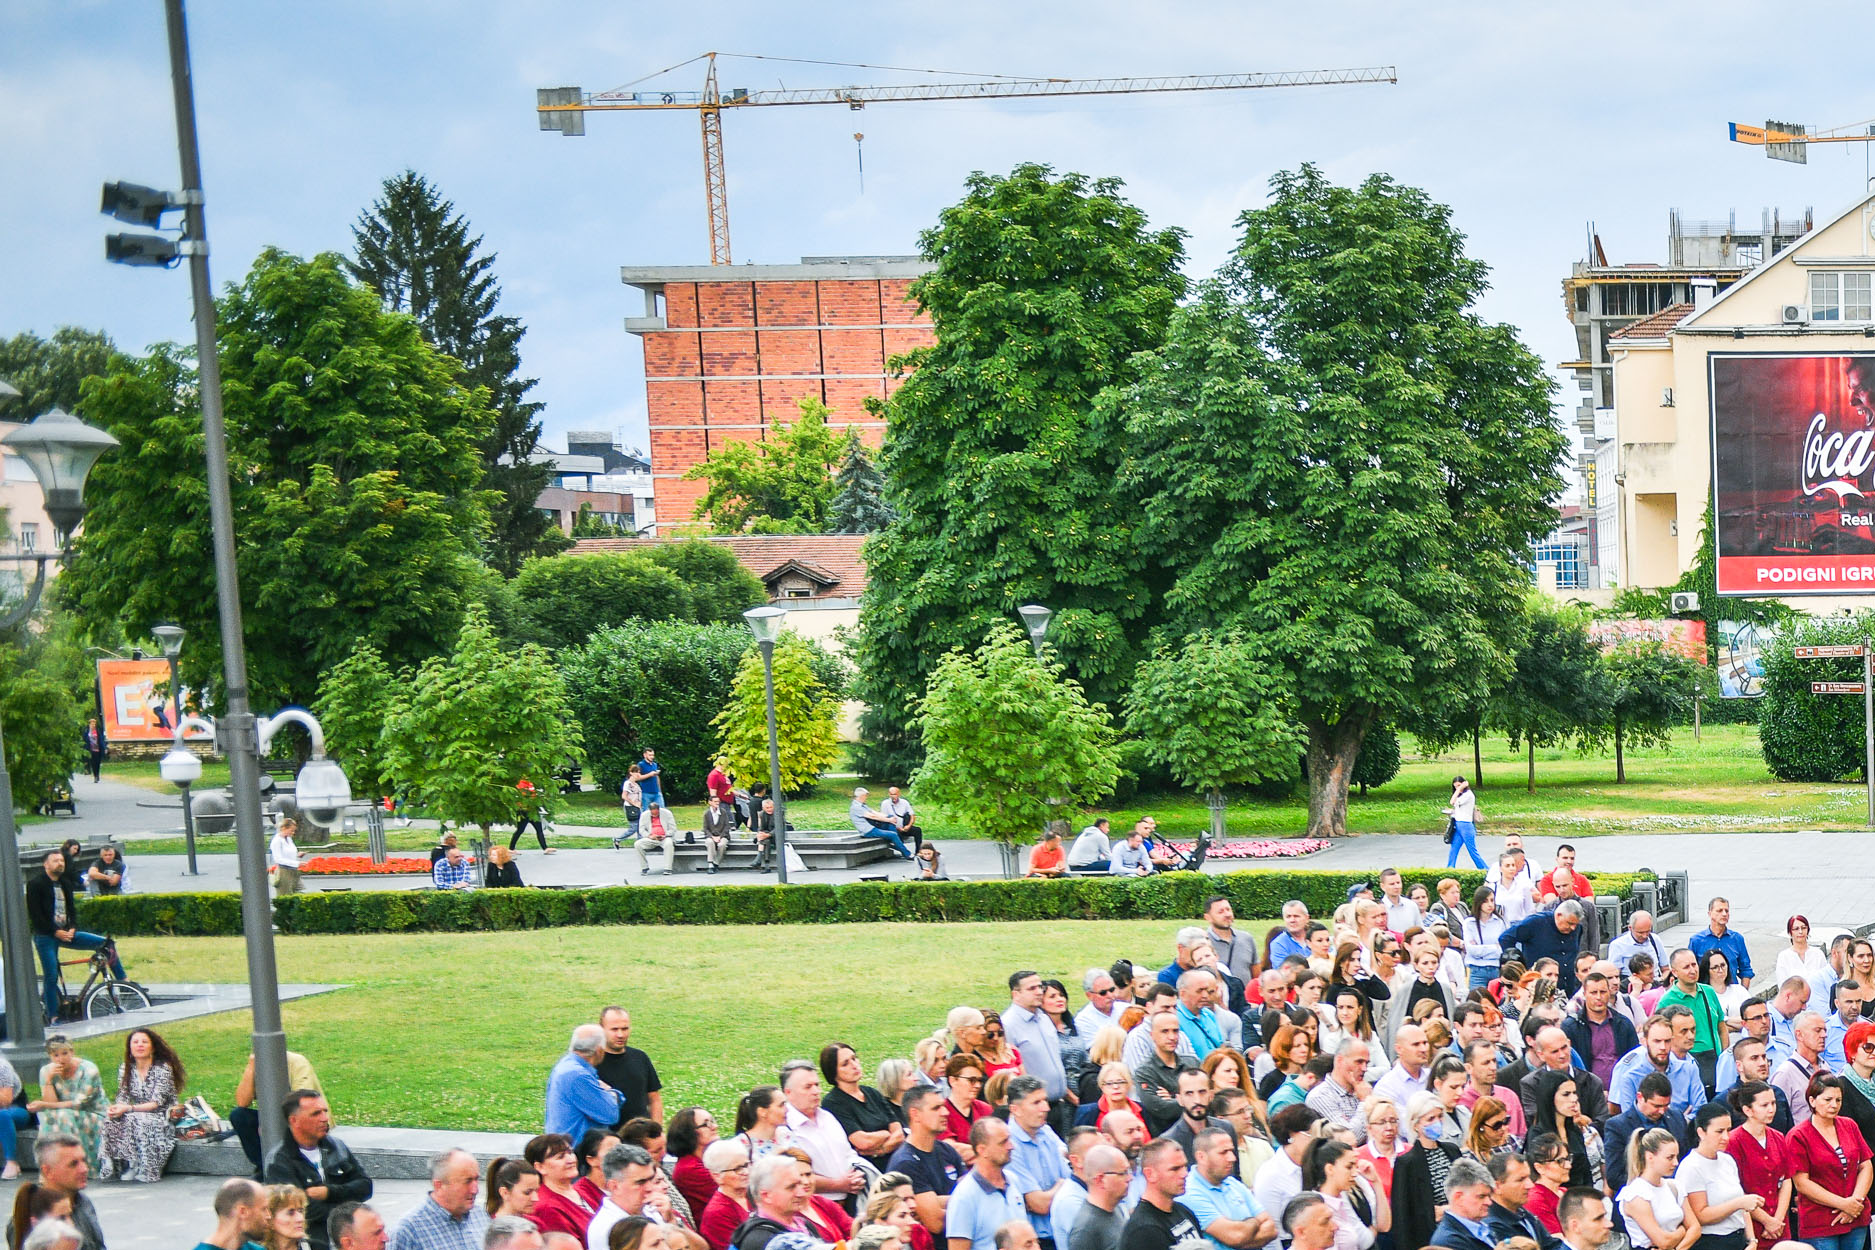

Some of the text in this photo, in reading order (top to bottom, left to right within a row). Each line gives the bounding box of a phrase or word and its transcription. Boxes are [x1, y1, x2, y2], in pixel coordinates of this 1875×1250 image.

[1587, 463, 1596, 506] HOTEL
[1842, 513, 1873, 526] Real
[1757, 567, 1836, 583] PODIGNI
